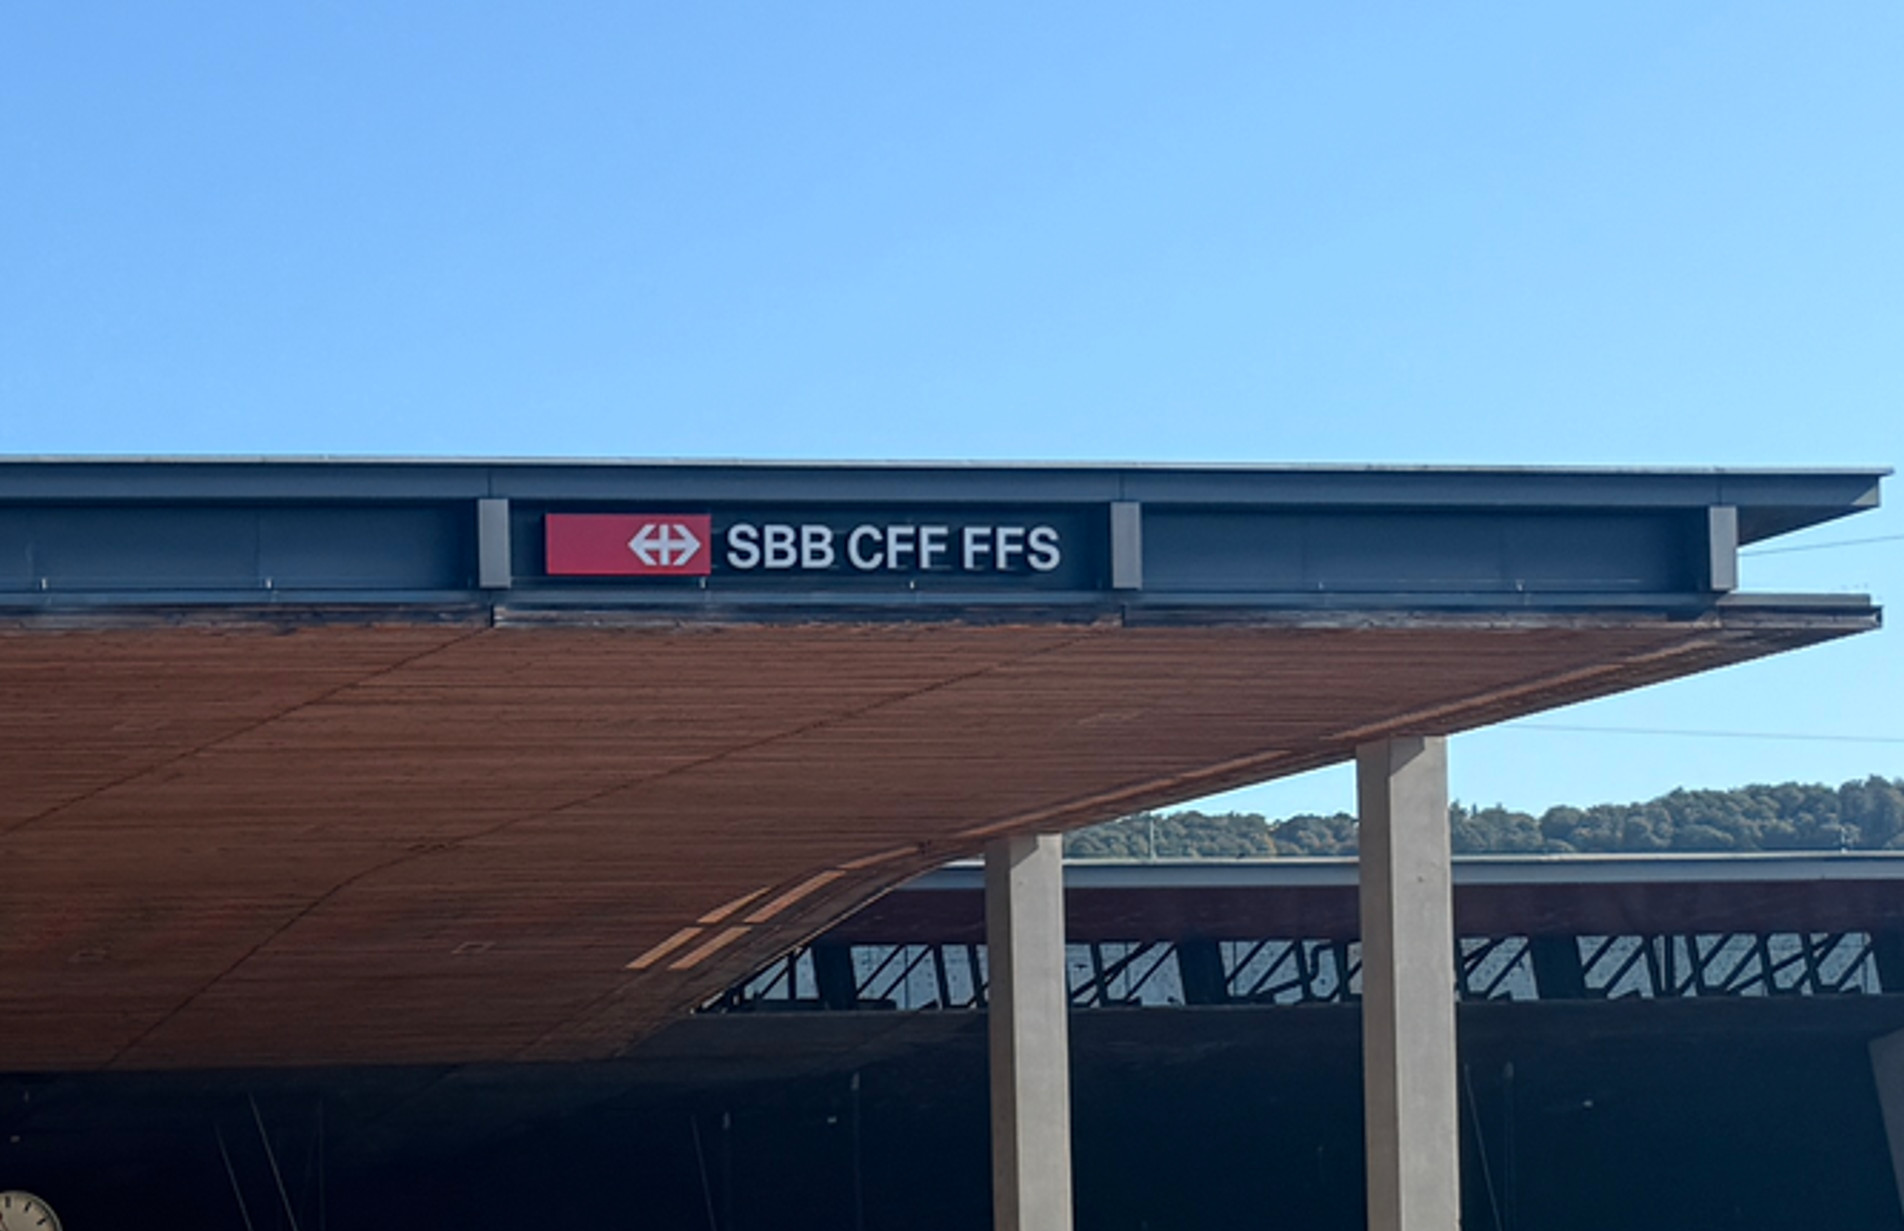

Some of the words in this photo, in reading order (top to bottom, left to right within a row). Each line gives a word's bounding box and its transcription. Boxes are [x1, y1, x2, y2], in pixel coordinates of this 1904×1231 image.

[727, 524, 835, 569] SBB
[848, 524, 948, 569] CFF
[963, 526, 1060, 570] FFS
